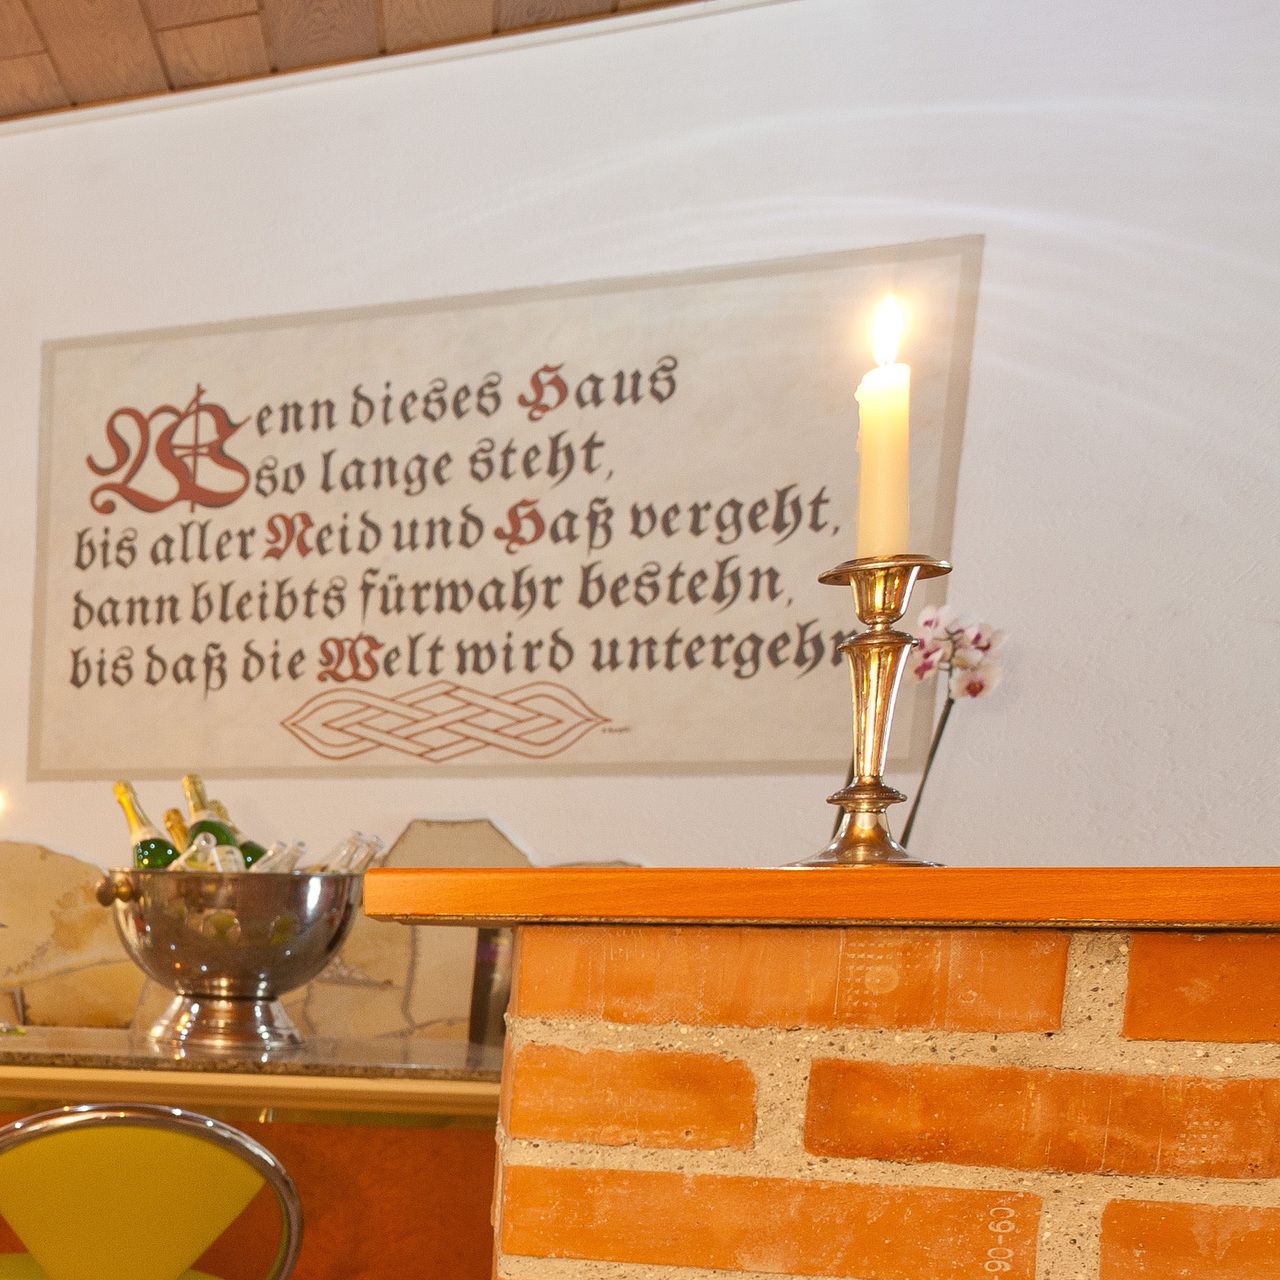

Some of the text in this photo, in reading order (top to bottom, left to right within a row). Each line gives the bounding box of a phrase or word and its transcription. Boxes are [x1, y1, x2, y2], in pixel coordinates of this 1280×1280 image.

[85, 355, 679, 515] Wenn dieses Haus
[253, 430, 615, 498] so lange steht,
[73, 483, 842, 571] bis aller Neid und Haß vergeht,
[72, 553, 794, 631] dann bleibts fürwahr bestehn,
[69, 646, 135, 690] bis
[143, 642, 229, 700] daß
[241, 638, 307, 684] die
[316, 630, 448, 684] Welt
[455, 628, 575, 676] wird
